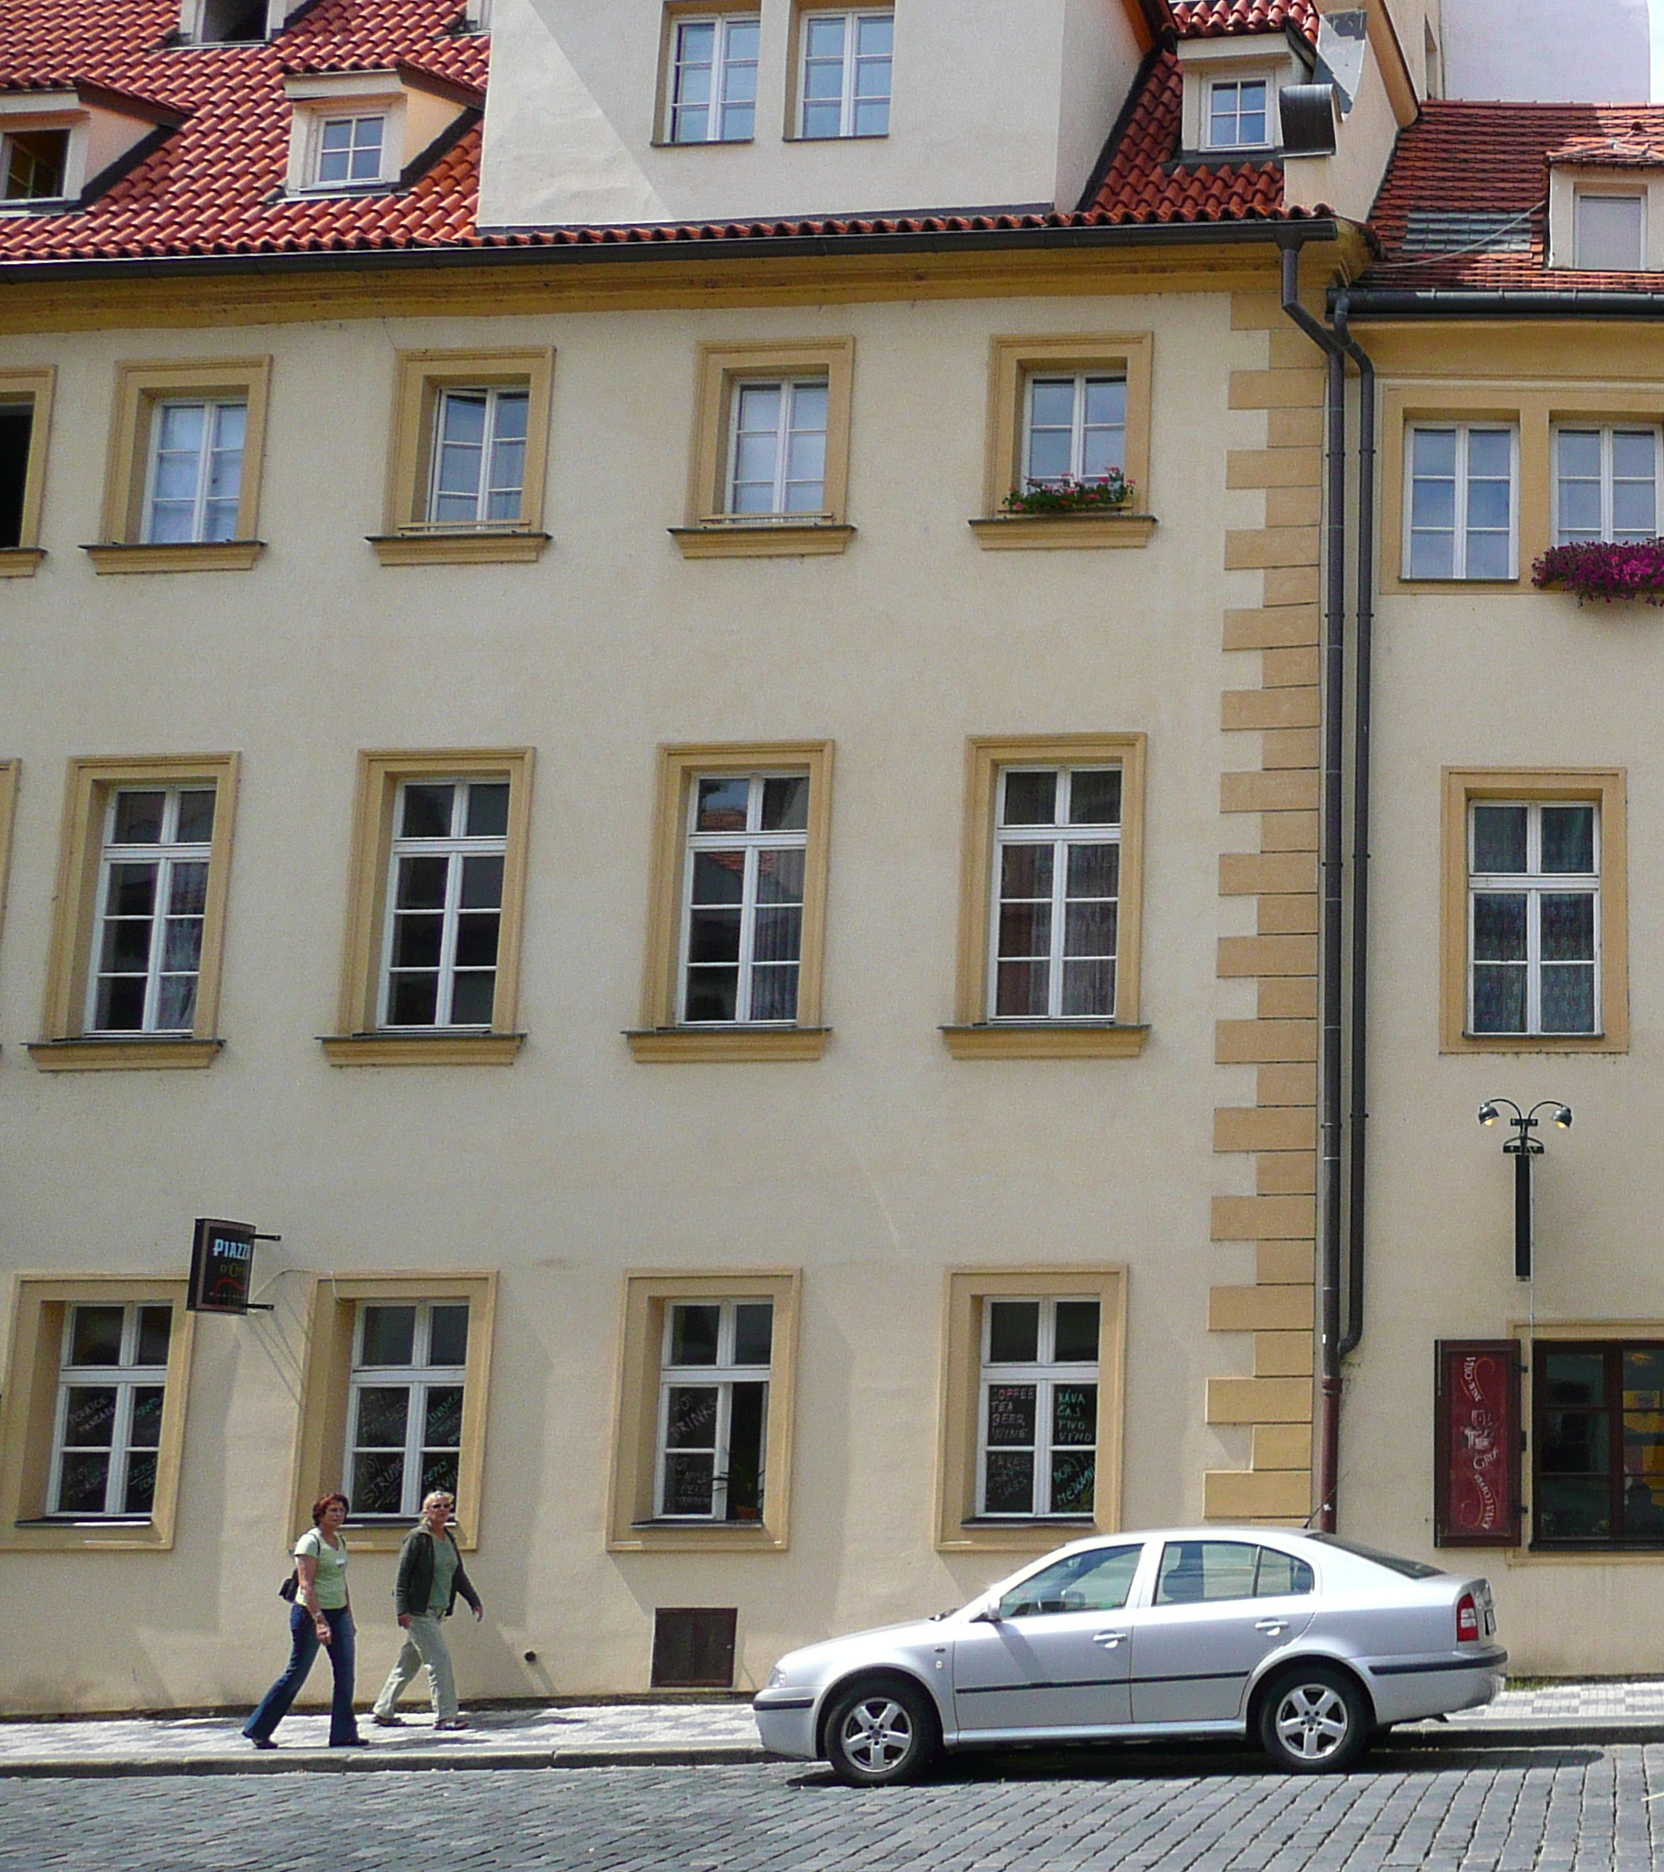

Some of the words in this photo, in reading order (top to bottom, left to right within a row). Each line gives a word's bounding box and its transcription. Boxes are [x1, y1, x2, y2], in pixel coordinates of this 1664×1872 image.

[991, 1401, 1013, 1413] TEA
[992, 1414, 1026, 1426] BEER
[1058, 1420, 1086, 1430] PIVO
[991, 1428, 1029, 1440] WINE
